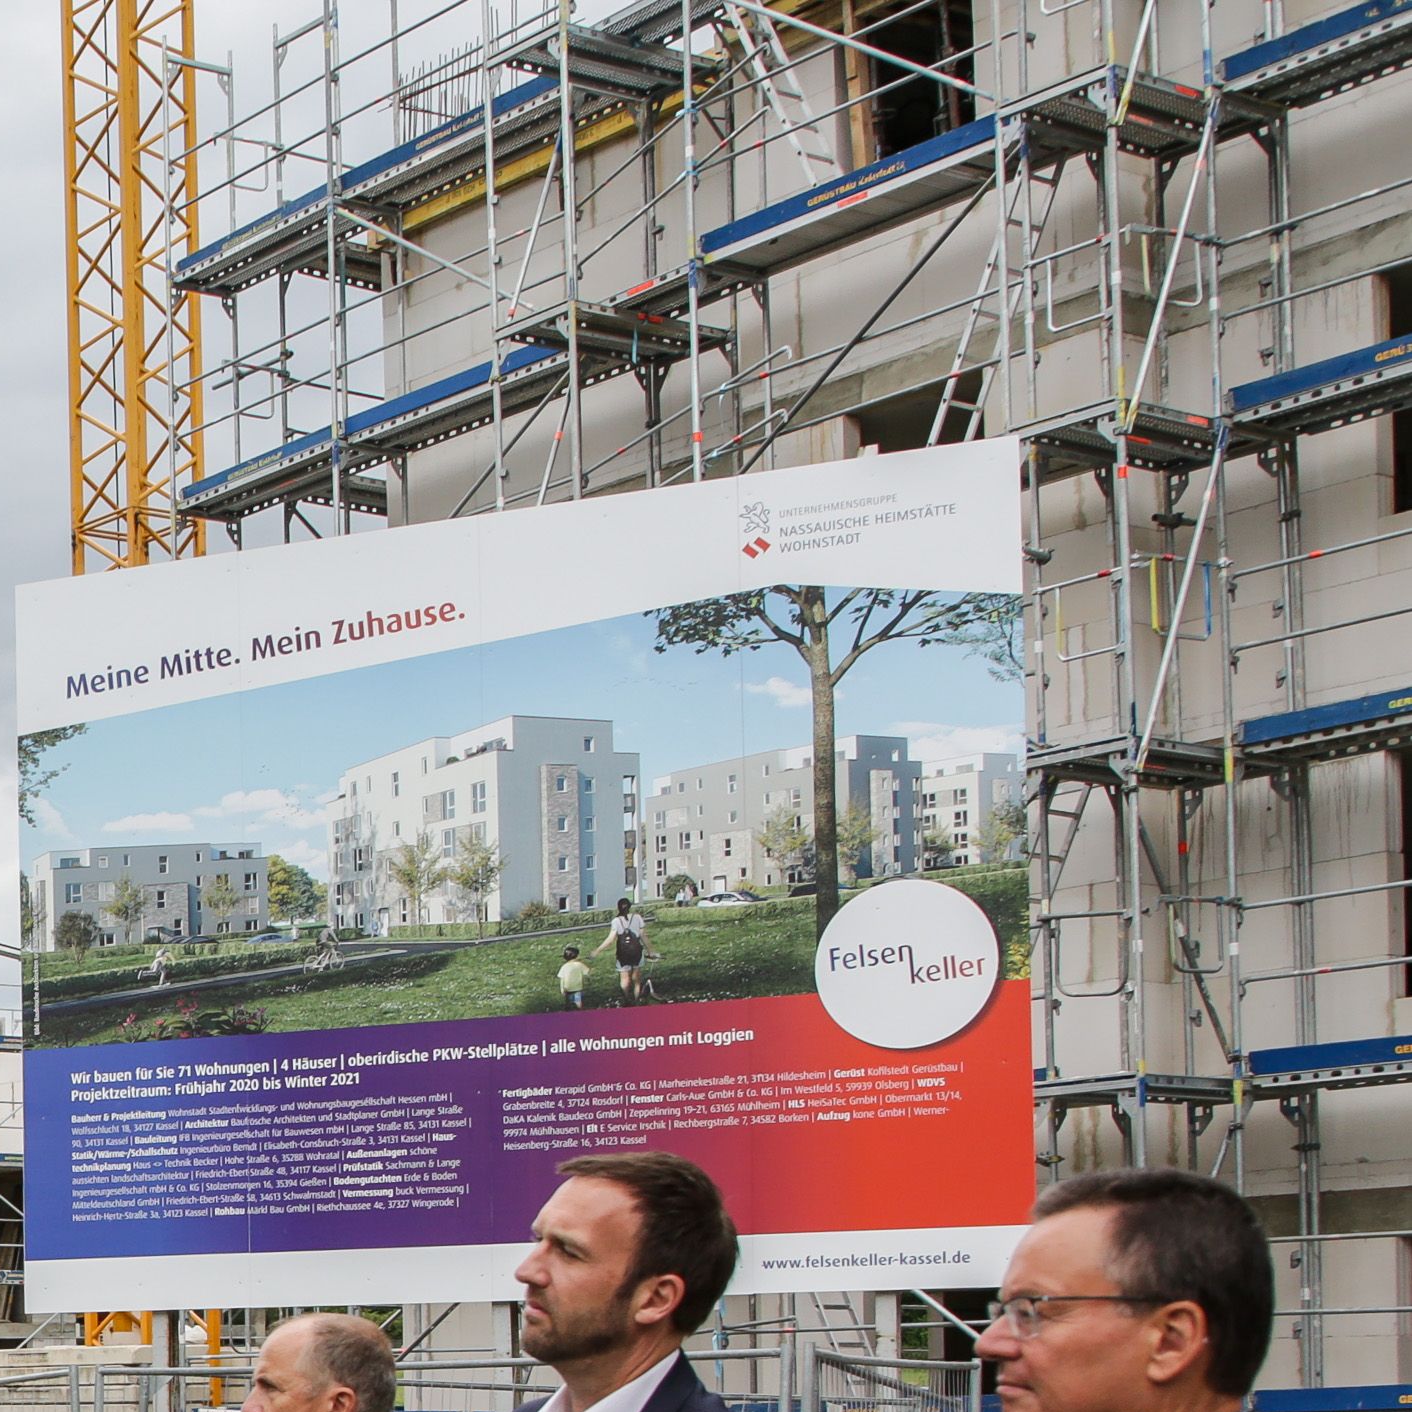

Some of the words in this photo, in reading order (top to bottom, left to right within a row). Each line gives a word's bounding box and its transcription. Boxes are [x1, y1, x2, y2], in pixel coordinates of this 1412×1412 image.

[778, 493, 898, 519] UNTERNEHMENSGRUPPE
[779, 514, 871, 537] NASSAUISCHE
[875, 503, 956, 525] HEIMSTÄTTE
[779, 532, 862, 553] WOHNSTADT
[65, 664, 149, 699] Meine
[159, 646, 241, 680] Mitte.
[250, 626, 322, 661] Mein
[331, 602, 466, 646] Zuhause.
[829, 944, 913, 972] Felsen
[910, 954, 985, 984] keller
[70, 1071, 91, 1084] Wir
[94, 1068, 131, 1083] bauen
[135, 1067, 153, 1080] für
[155, 1066, 174, 1079] Sie
[178, 1064, 191, 1077] 71
[194, 1060, 269, 1076] Wohnungen
[280, 1058, 288, 1071] 4
[292, 1055, 337, 1070] Häuser
[347, 1050, 428, 1067] oberirdische
[432, 1043, 538, 1062] PKW-Stellplätze
[550, 1040, 576, 1054] alle
[579, 1035, 664, 1052] Wohnungen
[668, 1033, 692, 1047] mit
[697, 1029, 754, 1047] Loggien
[71, 1083, 171, 1103] Projektzeitraum:
[174, 1080, 226, 1096] Frühjahr
[229, 1078, 259, 1092] 2020
[262, 1076, 281, 1090] bis
[284, 1074, 327, 1088] Winter
[330, 1072, 359, 1086] 2021
[502, 1086, 552, 1099] Fertigbäder
[587, 1082, 613, 1093] GmbH
[833, 1068, 865, 1079] Gerüst
[630, 1093, 664, 1104] Fenster
[707, 1089, 734, 1100] GmbH
[916, 1077, 945, 1088] WDVS
[70, 1112, 102, 1123] Bauherr
[110, 1109, 166, 1122] Projektleitung
[280, 1102, 295, 1112] und
[428, 1093, 447, 1103] mbH
[184, 1118, 229, 1130] Architektur
[317, 1113, 333, 1123] und
[380, 1109, 405, 1119] GmbH
[595, 1109, 622, 1119] GmbH
[787, 1099, 805, 1109] HLS
[848, 1095, 877, 1106] GmbH
[816, 1110, 850, 1122] Aufzug
[877, 1108, 905, 1118] GmbH
[71, 1146, 178, 1161] Statik/Wärme-/Schallschutz
[432, 1132, 456, 1142] Haus-
[134, 1133, 177, 1144] Bauleitung
[325, 1124, 344, 1134] mbH
[71, 1161, 131, 1173] technikplanung
[346, 1148, 408, 1160] Außenanlagen
[342, 1162, 383, 1173] Prüfstatik
[136, 1197, 160, 1207] GmbH
[342, 1187, 394, 1198] Vermessung
[415, 1184, 464, 1195] Vermessung
[148, 1184, 166, 1194] mbH
[333, 1173, 402, 1186] Bodengutachten
[214, 1207, 245, 1217] Rohbau
[286, 1204, 310, 1214] GmbH
[762, 1250, 972, 1270] www.felsenkeller-kassel.de
